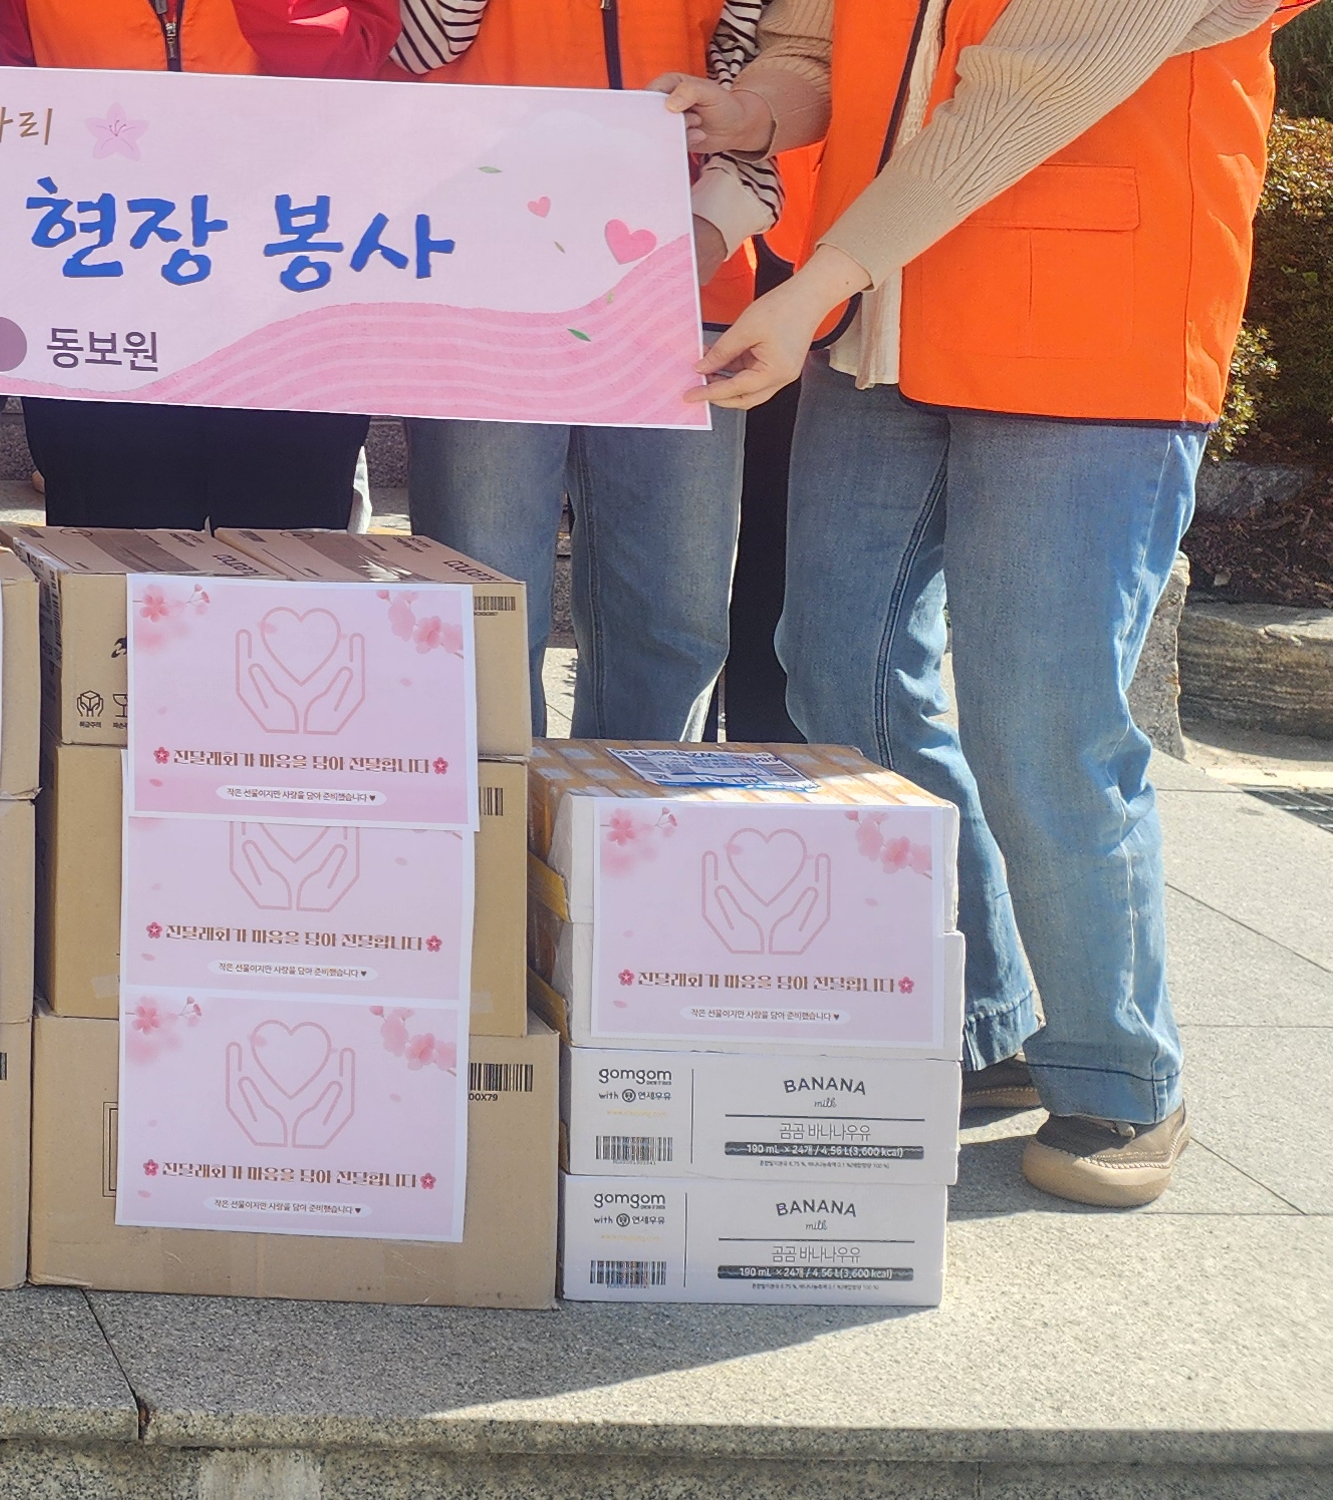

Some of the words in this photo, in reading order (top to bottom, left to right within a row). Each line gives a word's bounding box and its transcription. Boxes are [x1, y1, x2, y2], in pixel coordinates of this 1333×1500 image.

[27, 176, 228, 287] 현장
[263, 193, 456, 294] 봉사
[46, 328, 160, 373] 동보원
[174, 750, 254, 767] 진달래회가
[259, 753, 307, 769] 마음을
[312, 755, 343, 770] 담아
[348, 756, 429, 773] 전달합니다
[166, 925, 246, 942] 진달래회가
[252, 929, 299, 945] 마음을
[305, 931, 336, 946] 담아
[341, 933, 422, 951] 전달합니다
[638, 972, 718, 988] 진달래회가
[724, 974, 771, 990] 마음을
[777, 976, 808, 991] 담아
[813, 976, 894, 993] 전달합니다
[598, 1068, 672, 1084] gomgom
[783, 1076, 867, 1096] BANANA
[468, 1093, 499, 1101] 00X79
[598, 1091, 619, 1100] with
[637, 1091, 672, 1100] 연세우유
[813, 1097, 838, 1109] milk
[779, 1122, 805, 1140] 곰곰
[808, 1123, 871, 1141] 바나나우유
[746, 1144, 764, 1154] 190
[766, 1144, 780, 1154] mL
[162, 1162, 242, 1180] 진달래회가
[247, 1166, 294, 1182] 마음을
[300, 1169, 330, 1184] 담아
[336, 1170, 416, 1188] 전달합니다
[593, 1193, 666, 1209] gomgom
[775, 1199, 857, 1218] BANANA
[593, 1216, 613, 1224] with
[632, 1215, 666, 1225] 연세우유
[805, 1220, 829, 1231] milk
[771, 1246, 797, 1263] 곰곰
[799, 1246, 861, 1264] 바나나우유
[739, 1268, 756, 1277] 190
[757, 1268, 771, 1277] mL
